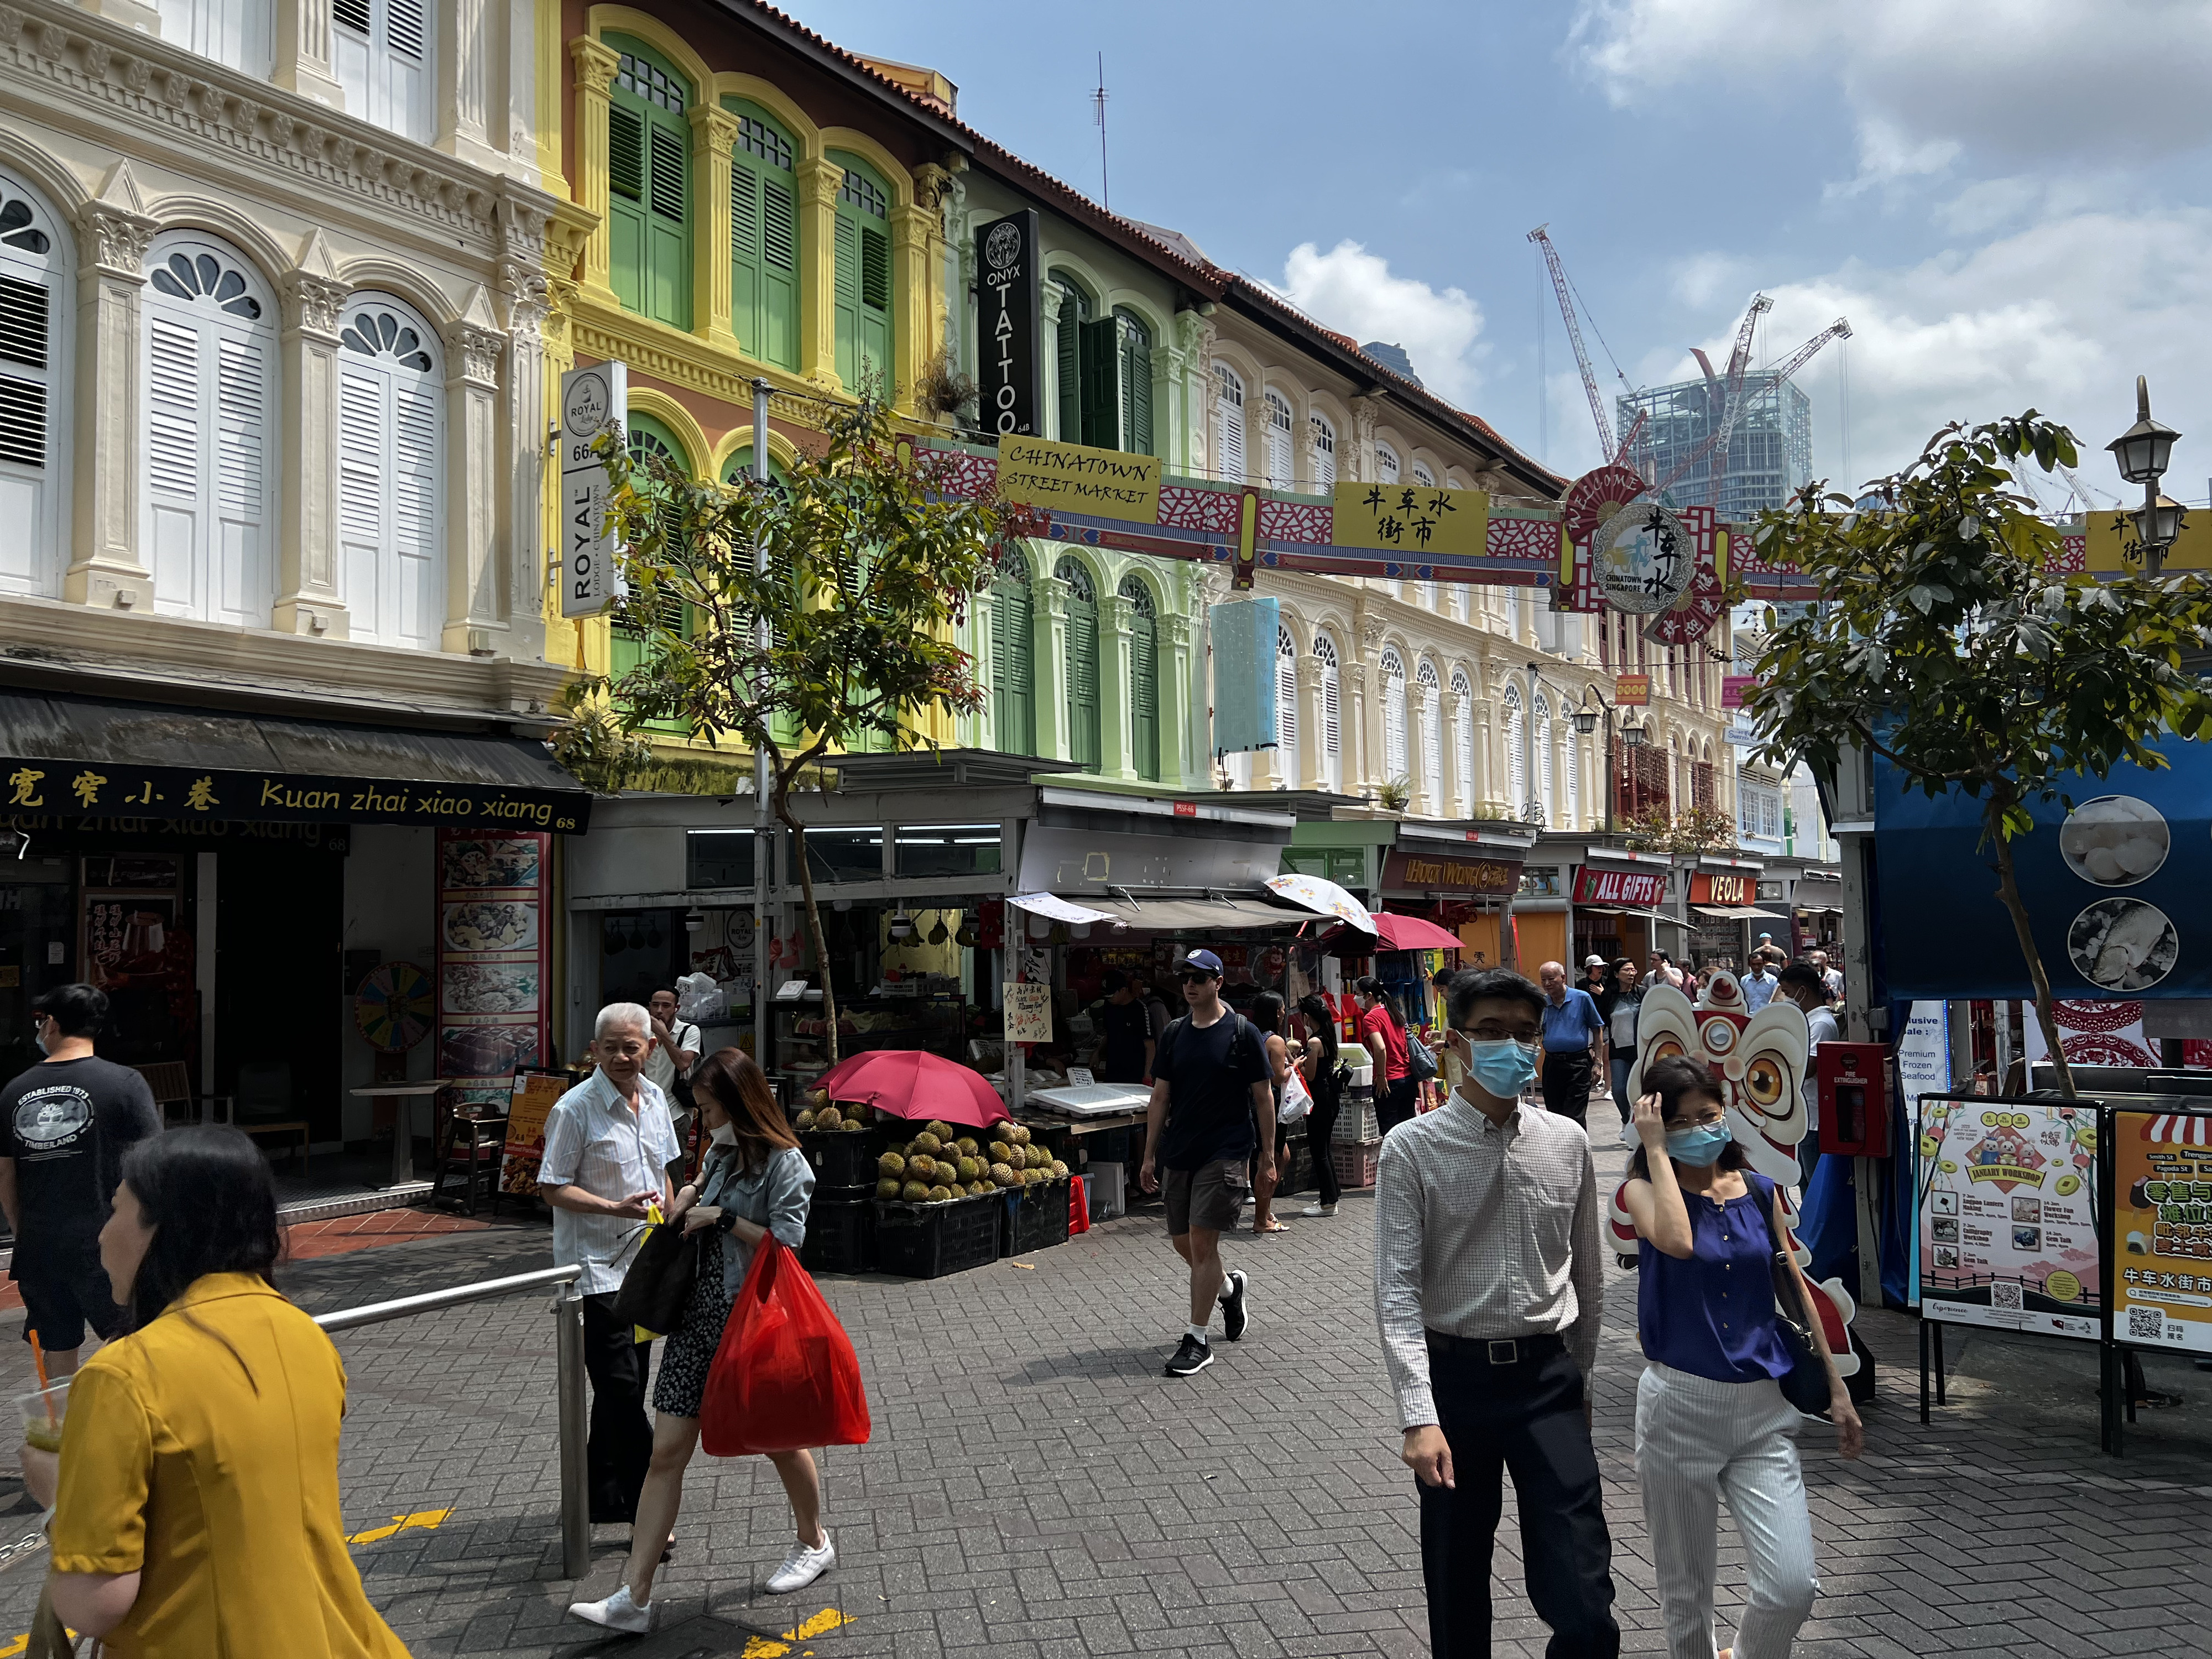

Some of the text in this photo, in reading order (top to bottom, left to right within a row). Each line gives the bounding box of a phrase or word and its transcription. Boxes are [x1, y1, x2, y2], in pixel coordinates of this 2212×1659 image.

[987, 264, 1020, 286] ONYX
[995, 283, 1016, 435] TATTOO
[571, 402, 602, 417] ROYAL
[1018, 424, 1030, 433] 64B
[1010, 446, 1151, 482] CHINATOWN
[1006, 472, 1149, 504] STREET MARKET
[1363, 484, 1457, 519] 牛车水
[1569, 474, 1639, 531] WELCOME
[1378, 515, 1437, 549] 街市
[575, 487, 591, 599] ROYAL
[1642, 507, 1682, 601] 牛车水
[1605, 583, 1641, 592] SINGAPORE
[1606, 574, 1642, 583] CHINATOWN
[260, 780, 576, 830] Kuan zhai xiao xiang 68
[1176, 804, 1194, 813] PSSF-66
[328, 838, 346, 852] 68
[1596, 873, 1653, 901] ALL GIFTS
[1712, 876, 1744, 902] VEOLA
[18, 1086, 89, 1105] ESTABLISHED 1973
[25, 1134, 77, 1150] TIMBERLAND
[1971, 1165, 2041, 1183] JANUARY WORKSHOP
[2044, 1212, 2071, 1220] Workshop
[1963, 1228, 1992, 1237] Calligraphy
[1963, 1234, 1989, 1242] Workshop
[2156, 1223, 2212, 1240] 毗邻牛
[2124, 1268, 2212, 1292] 牛车水街市
[1932, 1302, 1968, 1314] Experience
[2167, 1333, 2184, 1341] 报名
